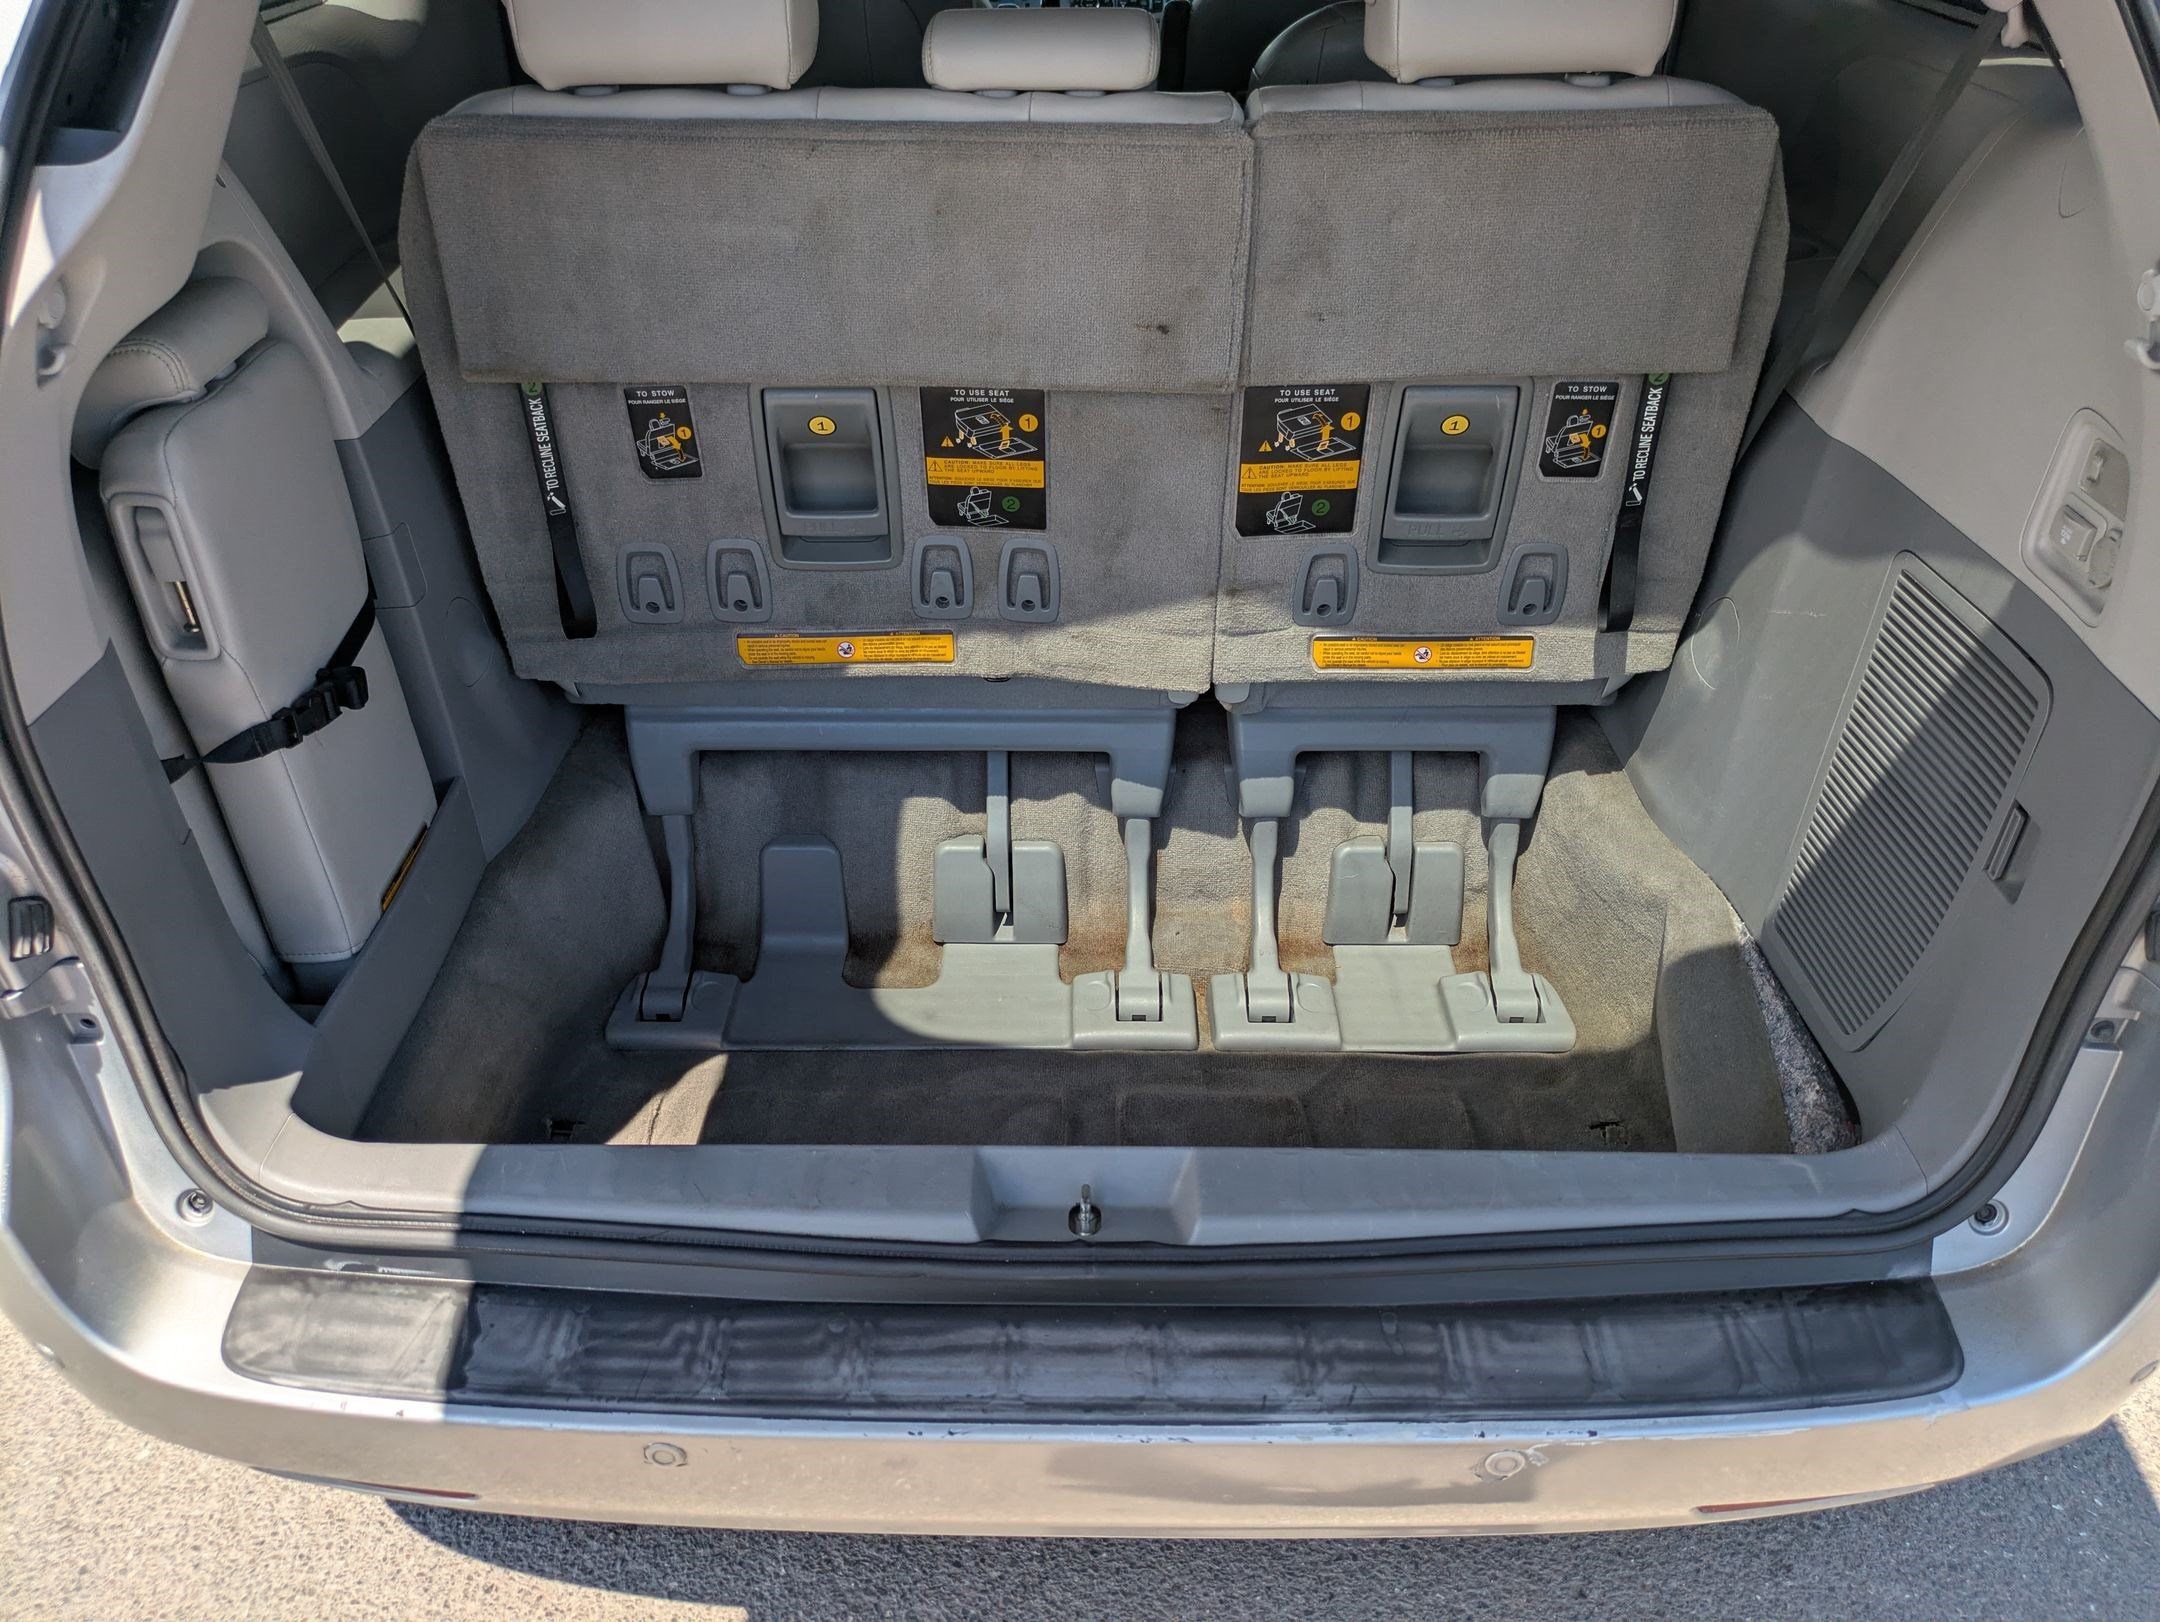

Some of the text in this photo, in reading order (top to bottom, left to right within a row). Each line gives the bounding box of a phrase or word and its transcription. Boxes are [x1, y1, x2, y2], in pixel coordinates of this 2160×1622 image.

[817, 421, 828, 431] 1
[1449, 420, 1460, 431] 1
[1633, 388, 1663, 481] TO RECLINE SEATBACK
[528, 398, 560, 491] TO RECLINE SEATBACK
[1006, 498, 1016, 510] 2
[1317, 502, 1326, 513] 2
[1408, 524, 1444, 537] PULL
